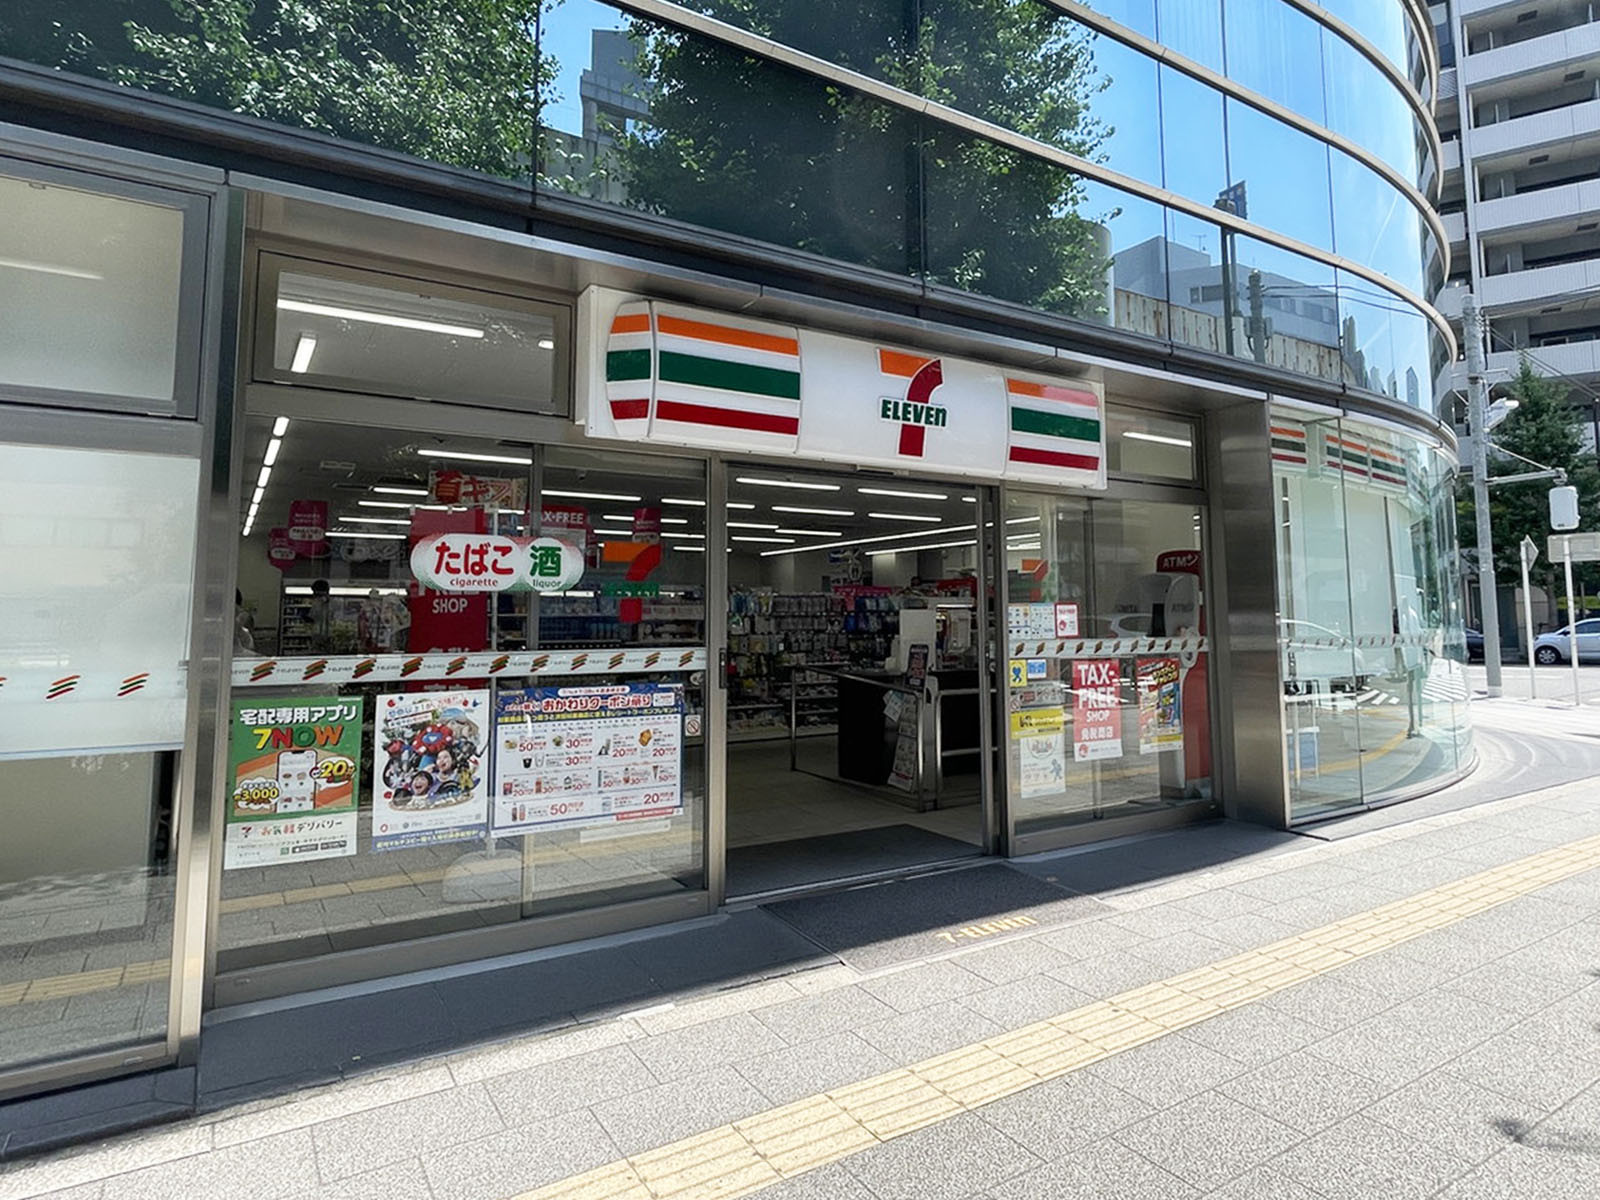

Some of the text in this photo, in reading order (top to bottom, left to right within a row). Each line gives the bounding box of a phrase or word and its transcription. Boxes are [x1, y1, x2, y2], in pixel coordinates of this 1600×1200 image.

[878, 349, 943, 458] 7
[434, 541, 514, 576] たばこ
[530, 545, 562, 577] 酒
[1163, 556, 1187, 568] ATM
[450, 578, 498, 588] cigarette
[533, 579, 561, 588] liquor
[432, 598, 468, 614] SHOP
[1078, 687, 1117, 709] FREE
[240, 705, 357, 726] 宅配専用アプリ
[1086, 710, 1111, 722] SHOP
[253, 725, 344, 750] 7NOW
